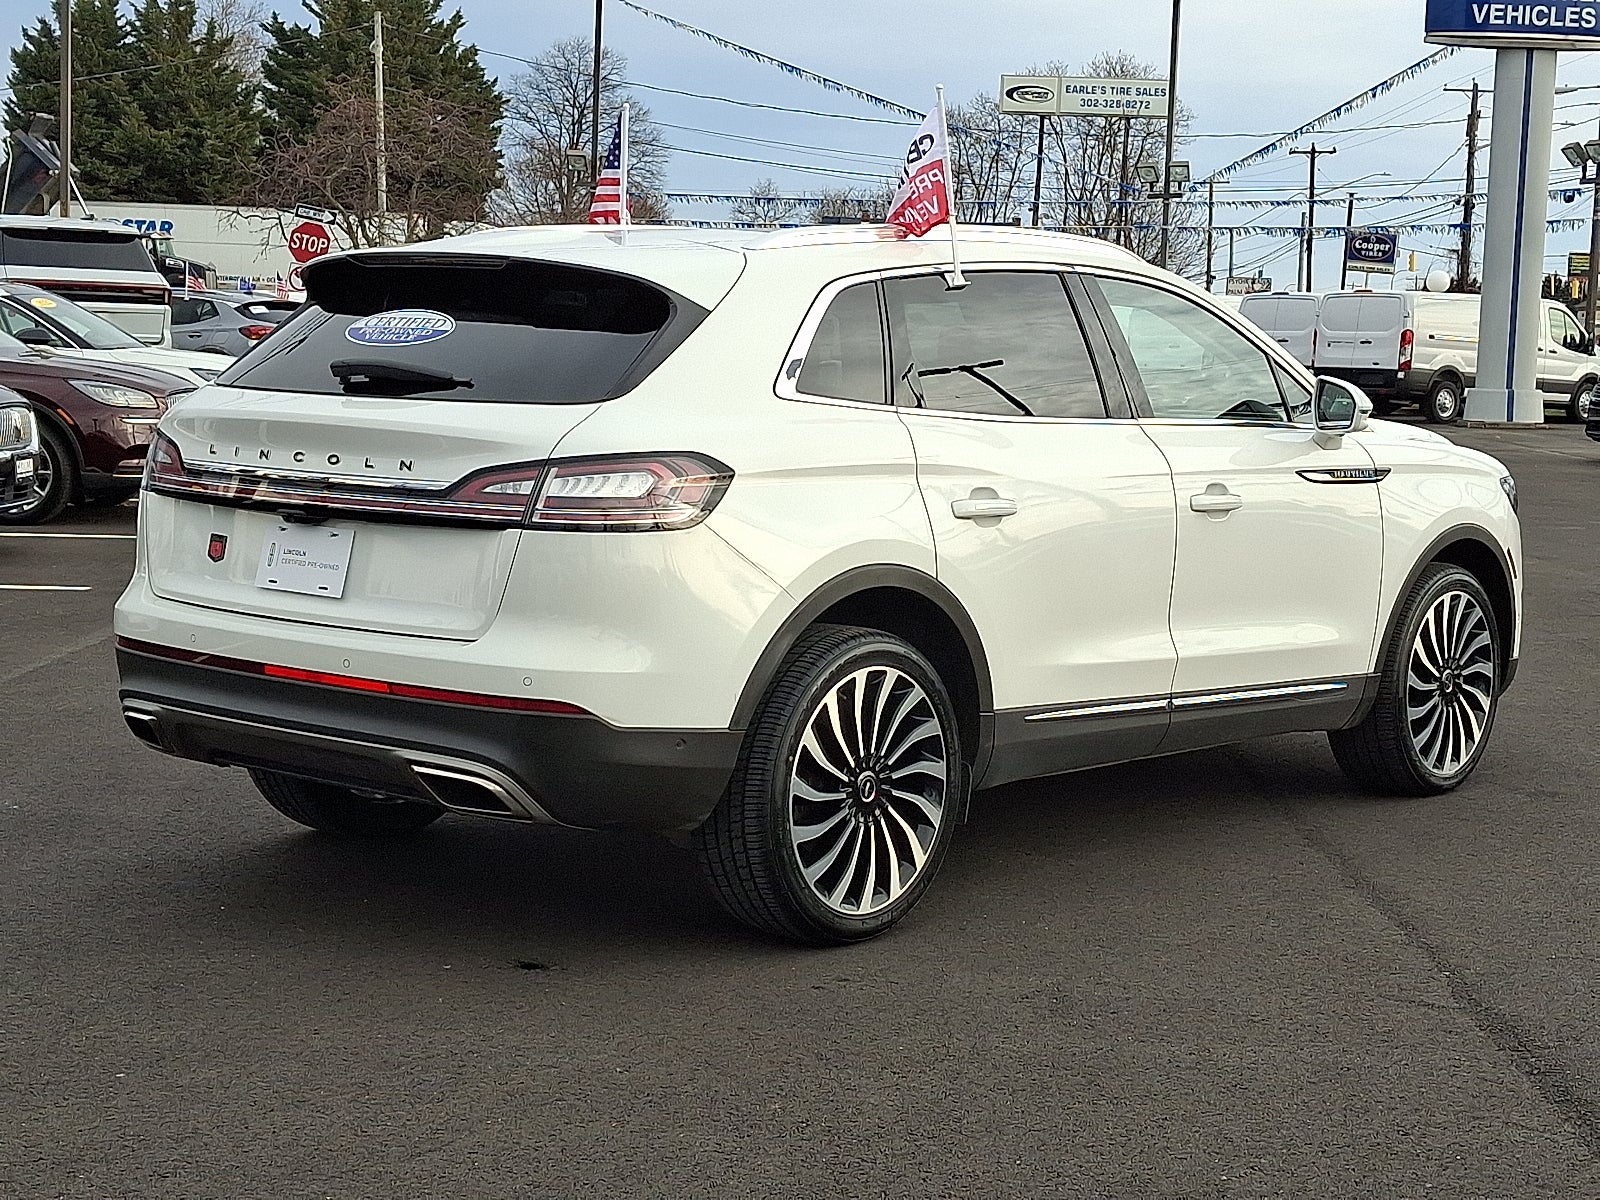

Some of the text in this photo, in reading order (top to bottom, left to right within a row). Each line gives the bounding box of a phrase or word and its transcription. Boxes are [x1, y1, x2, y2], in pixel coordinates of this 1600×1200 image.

[1472, 4, 1596, 28] VEHICLES
[1065, 84, 1167, 97] EARLE'S TIRE SALES
[1080, 98, 1151, 110] 302-328-8272
[291, 232, 328, 253] STOP
[1354, 239, 1391, 251] Cooper
[364, 316, 447, 328] CERTIFIED
[209, 444, 414, 472] LINCOLN
[283, 548, 307, 557] LINCOLN
[281, 558, 340, 571] CERTIFIED PRE-OWNED
